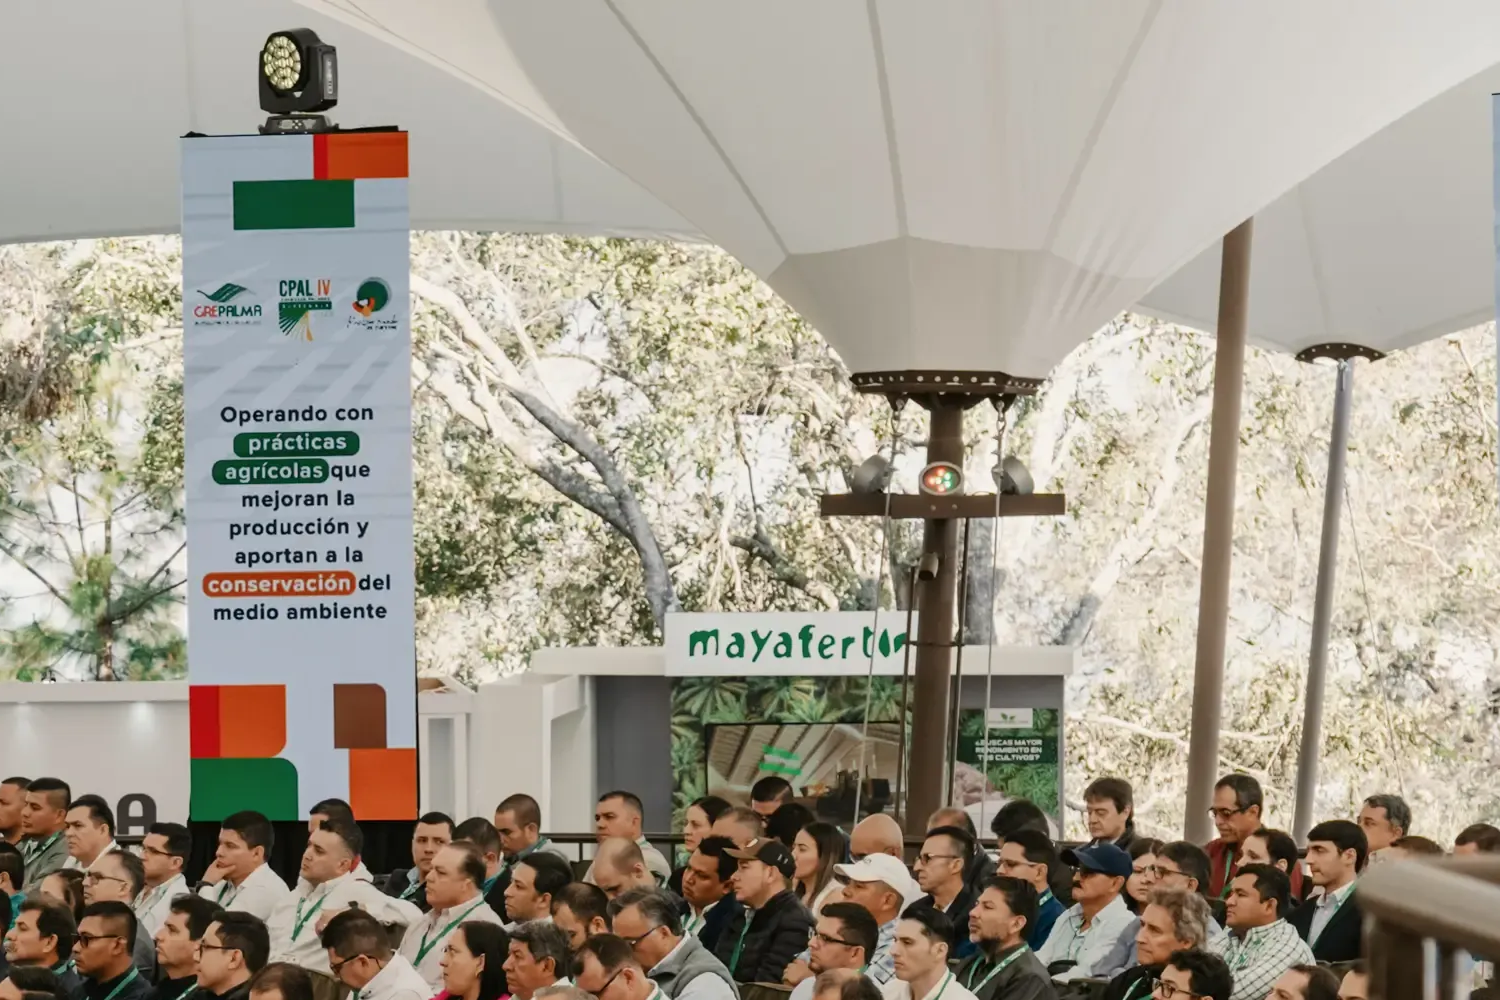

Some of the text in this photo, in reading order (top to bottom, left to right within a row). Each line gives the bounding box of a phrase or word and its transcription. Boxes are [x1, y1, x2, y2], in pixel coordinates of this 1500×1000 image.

[279, 279, 331, 297] CPAL IV
[193, 304, 262, 318] GREPALMA
[220, 406, 374, 426] Operando con
[248, 432, 347, 455] prácticas
[225, 460, 371, 484] agrícolas que
[241, 490, 355, 511] mejoran la
[229, 518, 369, 539] producción y
[235, 546, 363, 567] aportan a la
[207, 574, 391, 593] conservación del
[213, 602, 387, 620] medio ambiente
